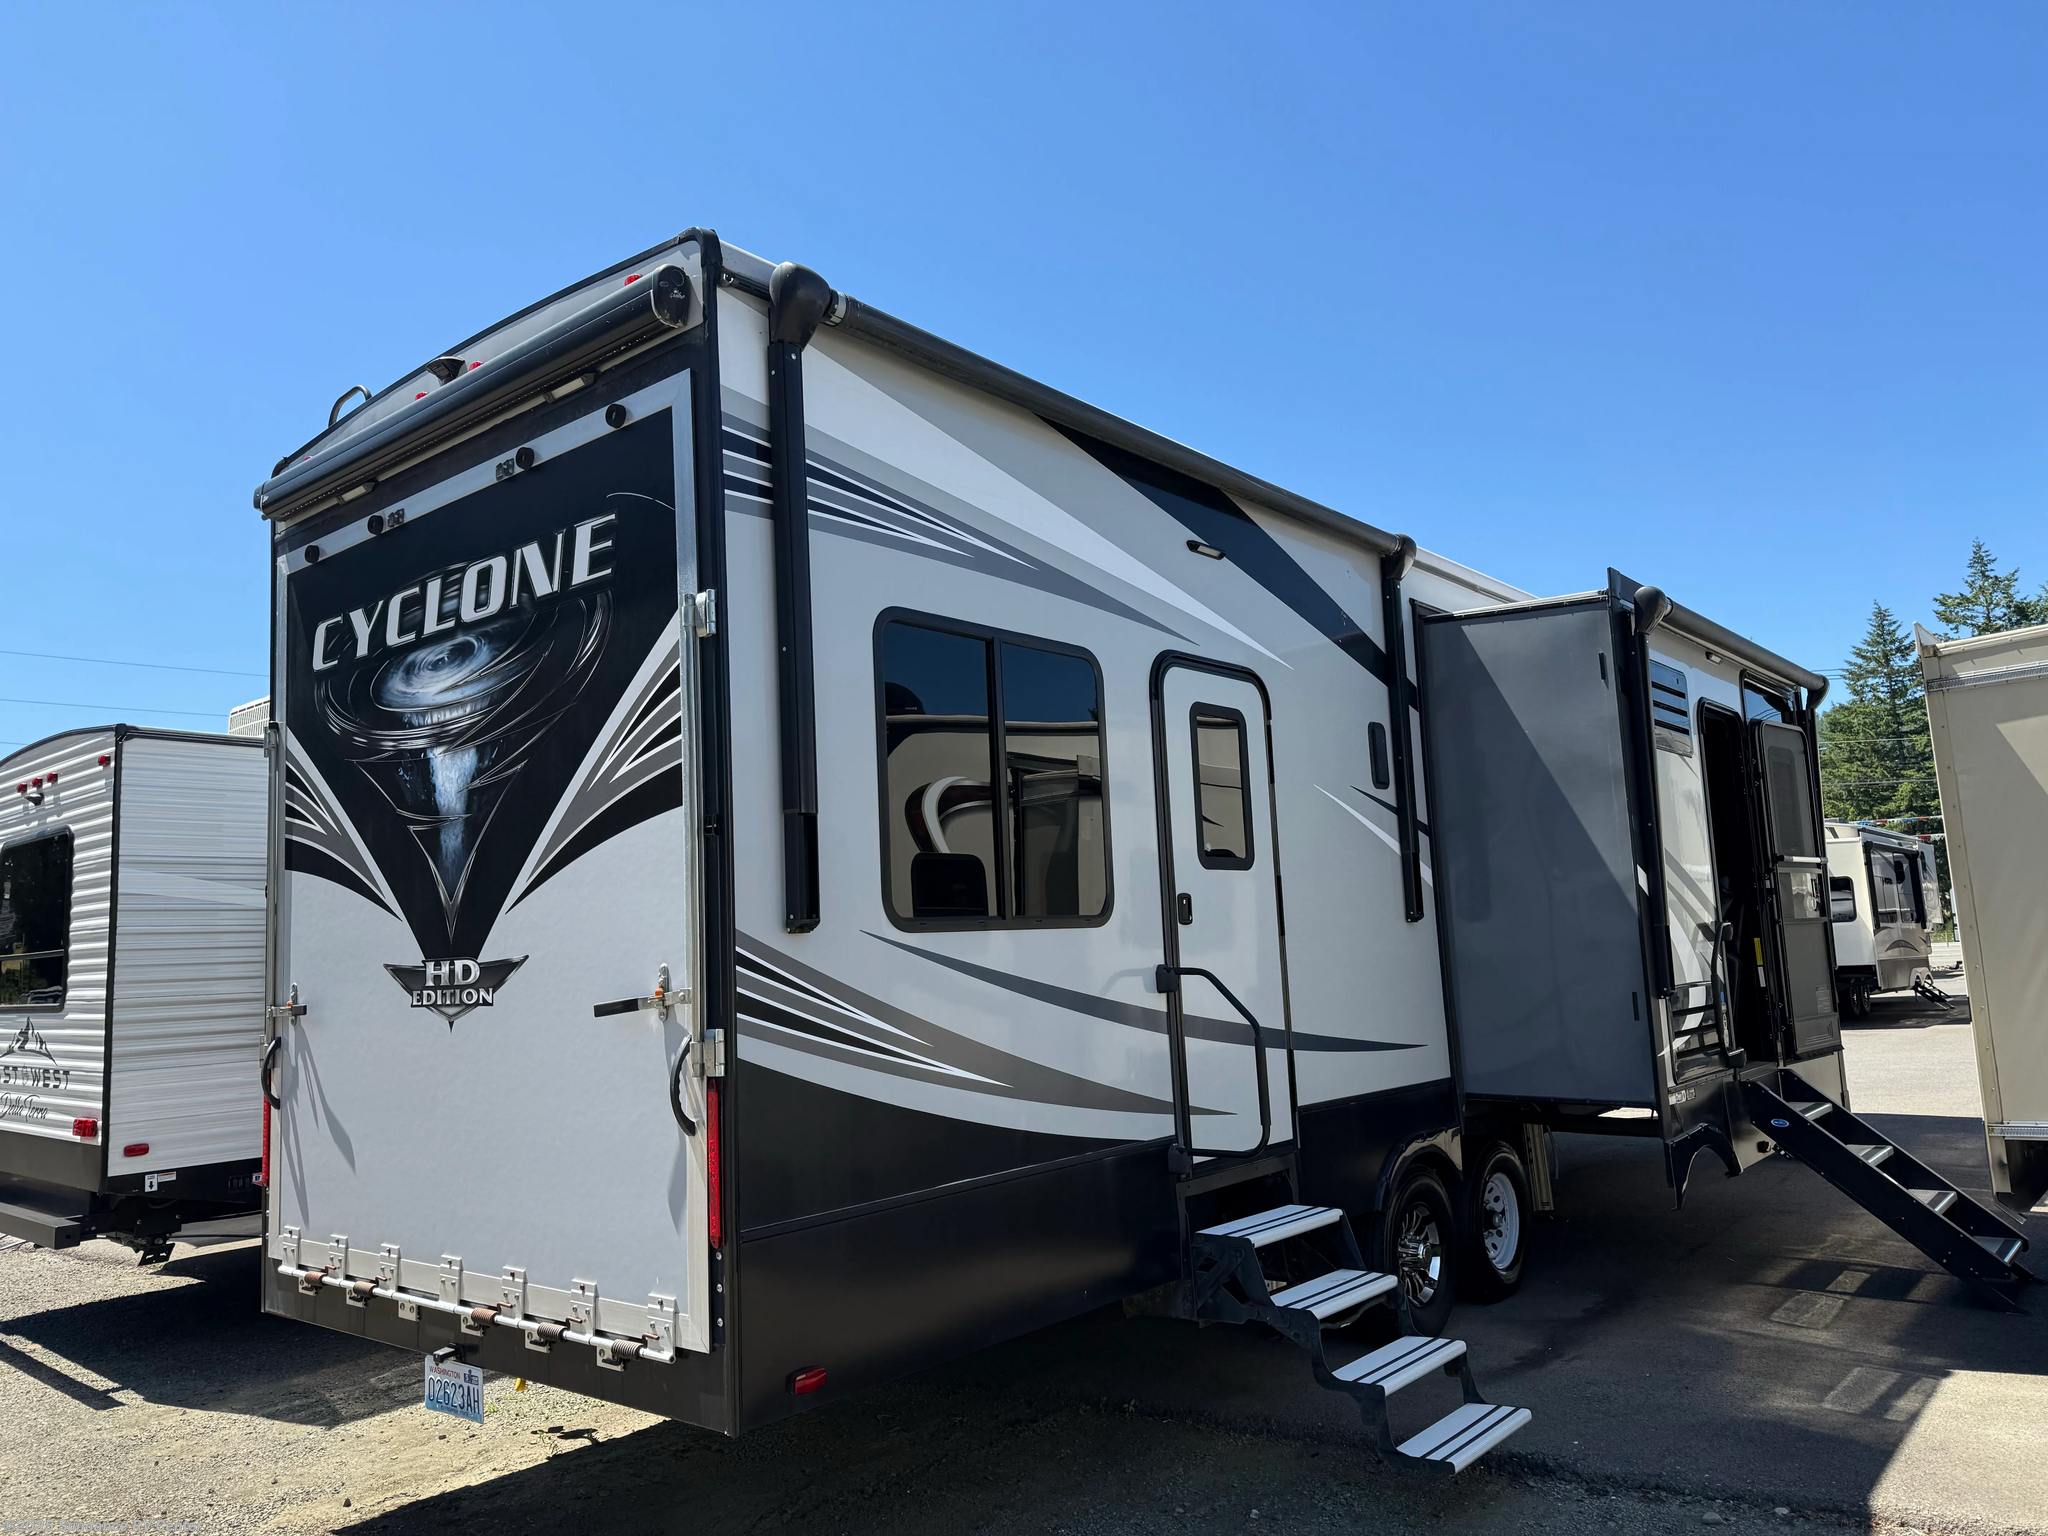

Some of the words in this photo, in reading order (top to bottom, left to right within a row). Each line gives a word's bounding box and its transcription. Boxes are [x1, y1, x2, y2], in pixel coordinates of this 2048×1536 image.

[312, 512, 617, 672] CYCLONE
[424, 959, 481, 987] HD
[412, 987, 494, 1006] EDITION
[31, 1067, 70, 1090] WEST
[0, 1092, 24, 1119] Della
[24, 1094, 49, 1122] Terra
[429, 1365, 461, 1380] WASHINGTON
[428, 1376, 480, 1415] 02623AH
